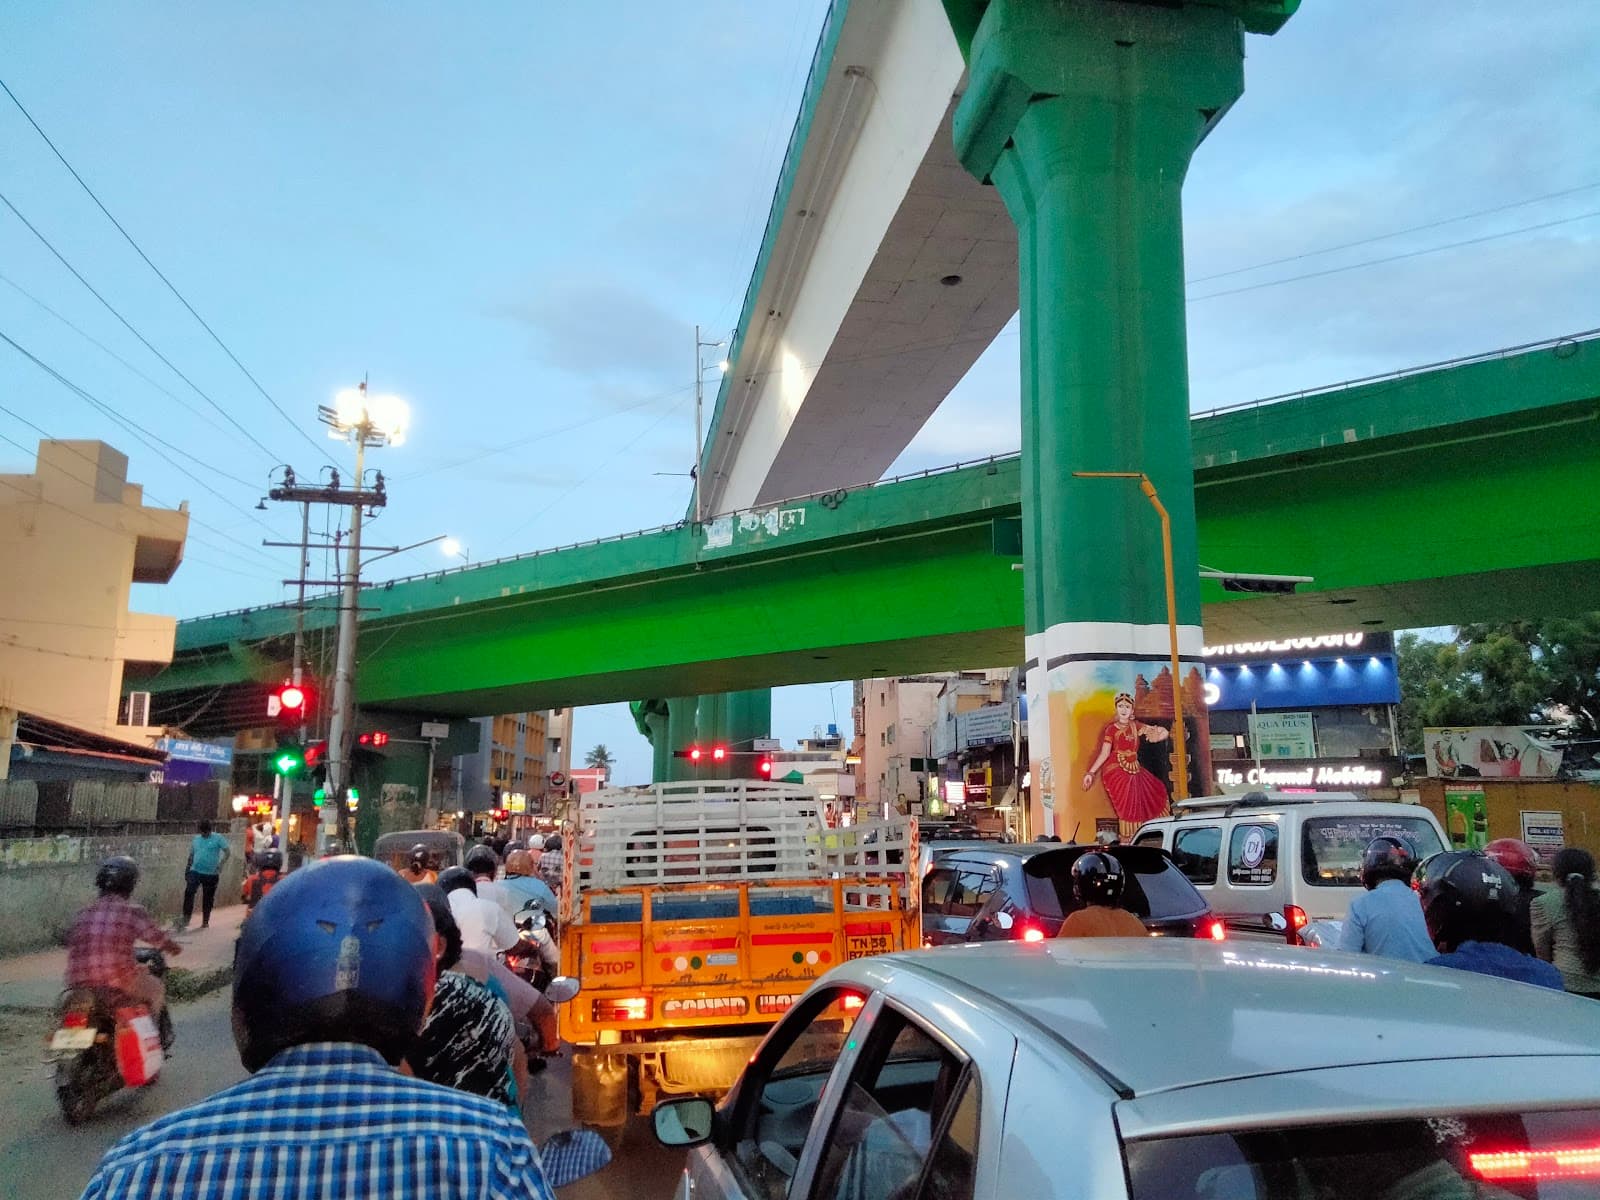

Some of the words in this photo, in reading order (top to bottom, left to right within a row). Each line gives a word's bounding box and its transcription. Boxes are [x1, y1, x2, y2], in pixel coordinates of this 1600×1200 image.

[1256, 721, 1279, 729] QUA
[1217, 768, 1243, 785] The
[1247, 767, 1314, 785] Chennai
[1316, 766, 1383, 785] Mobiles
[592, 961, 635, 975] STOP
[664, 998, 746, 1018] SOUND
